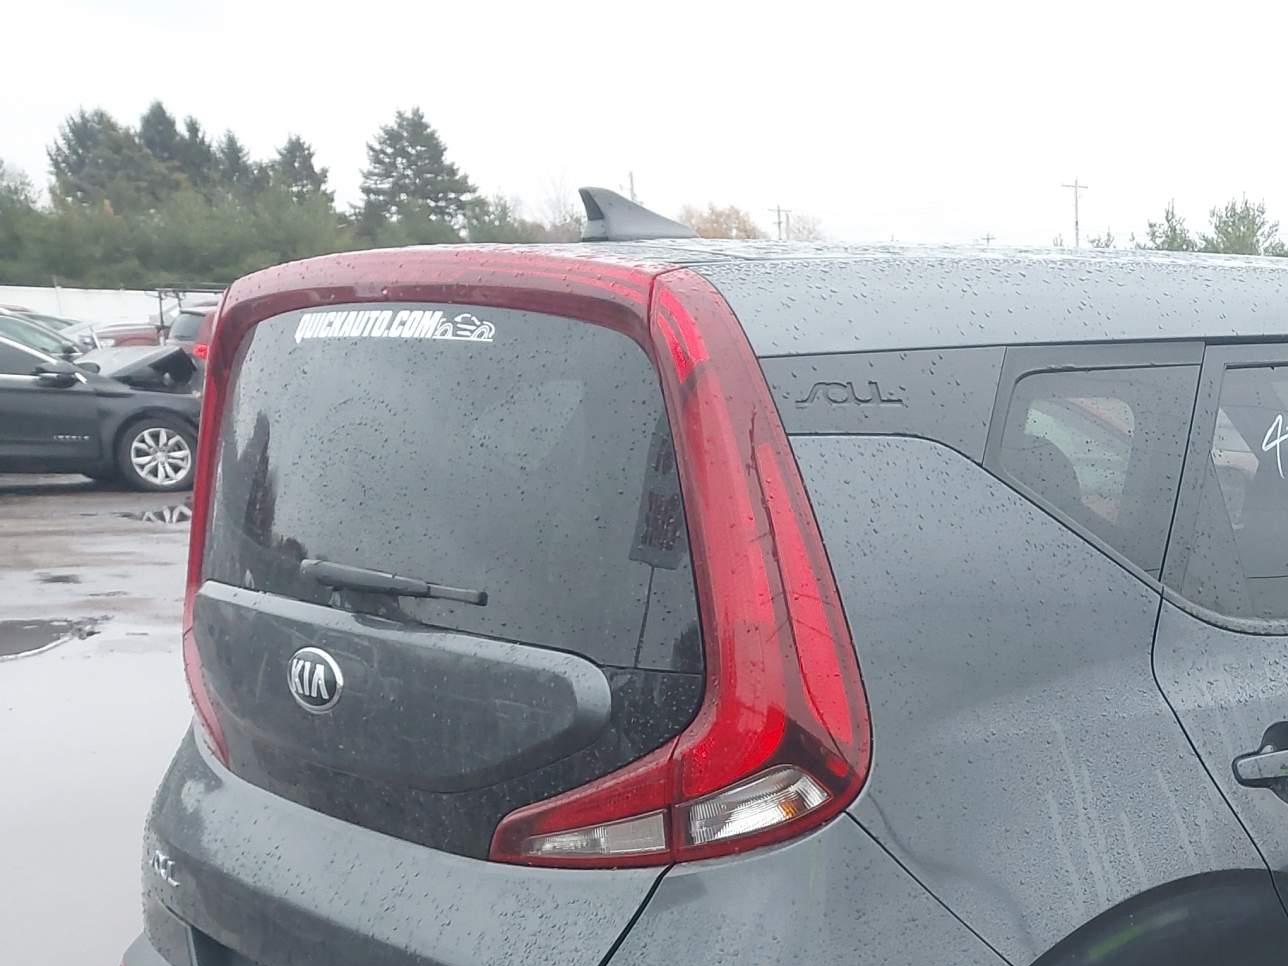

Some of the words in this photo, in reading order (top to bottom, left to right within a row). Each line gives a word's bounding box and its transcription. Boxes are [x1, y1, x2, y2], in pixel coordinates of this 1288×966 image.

[295, 310, 443, 344] QUICKAUTO.COM
[795, 380, 903, 406] SOUL
[291, 658, 330, 700] KIA
